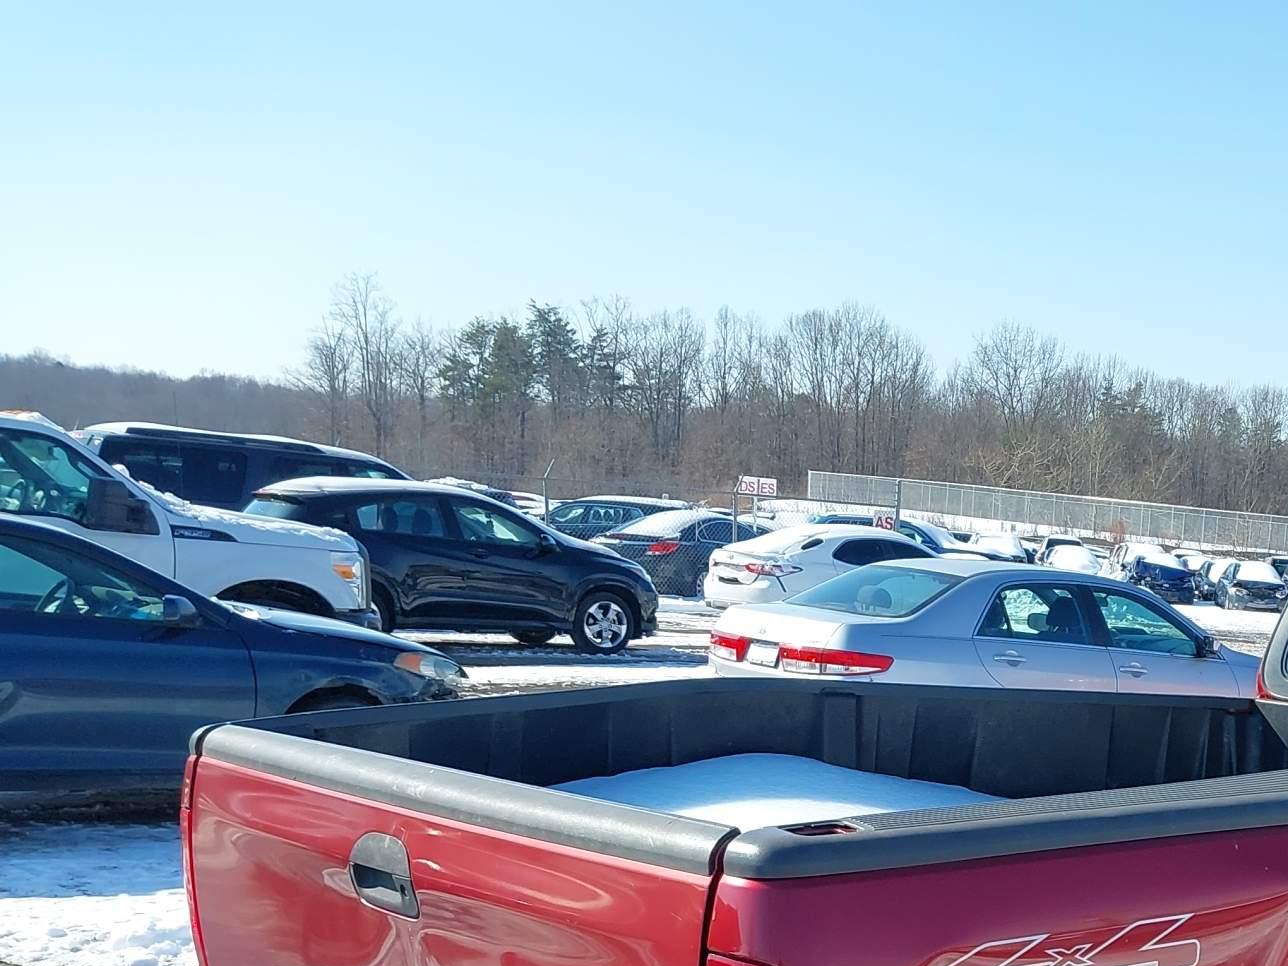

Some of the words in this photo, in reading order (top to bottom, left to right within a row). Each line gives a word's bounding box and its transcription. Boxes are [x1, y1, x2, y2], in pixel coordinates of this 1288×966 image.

[739, 481, 756, 493] DS
[760, 482, 776, 494] ES
[875, 516, 894, 530] AS
